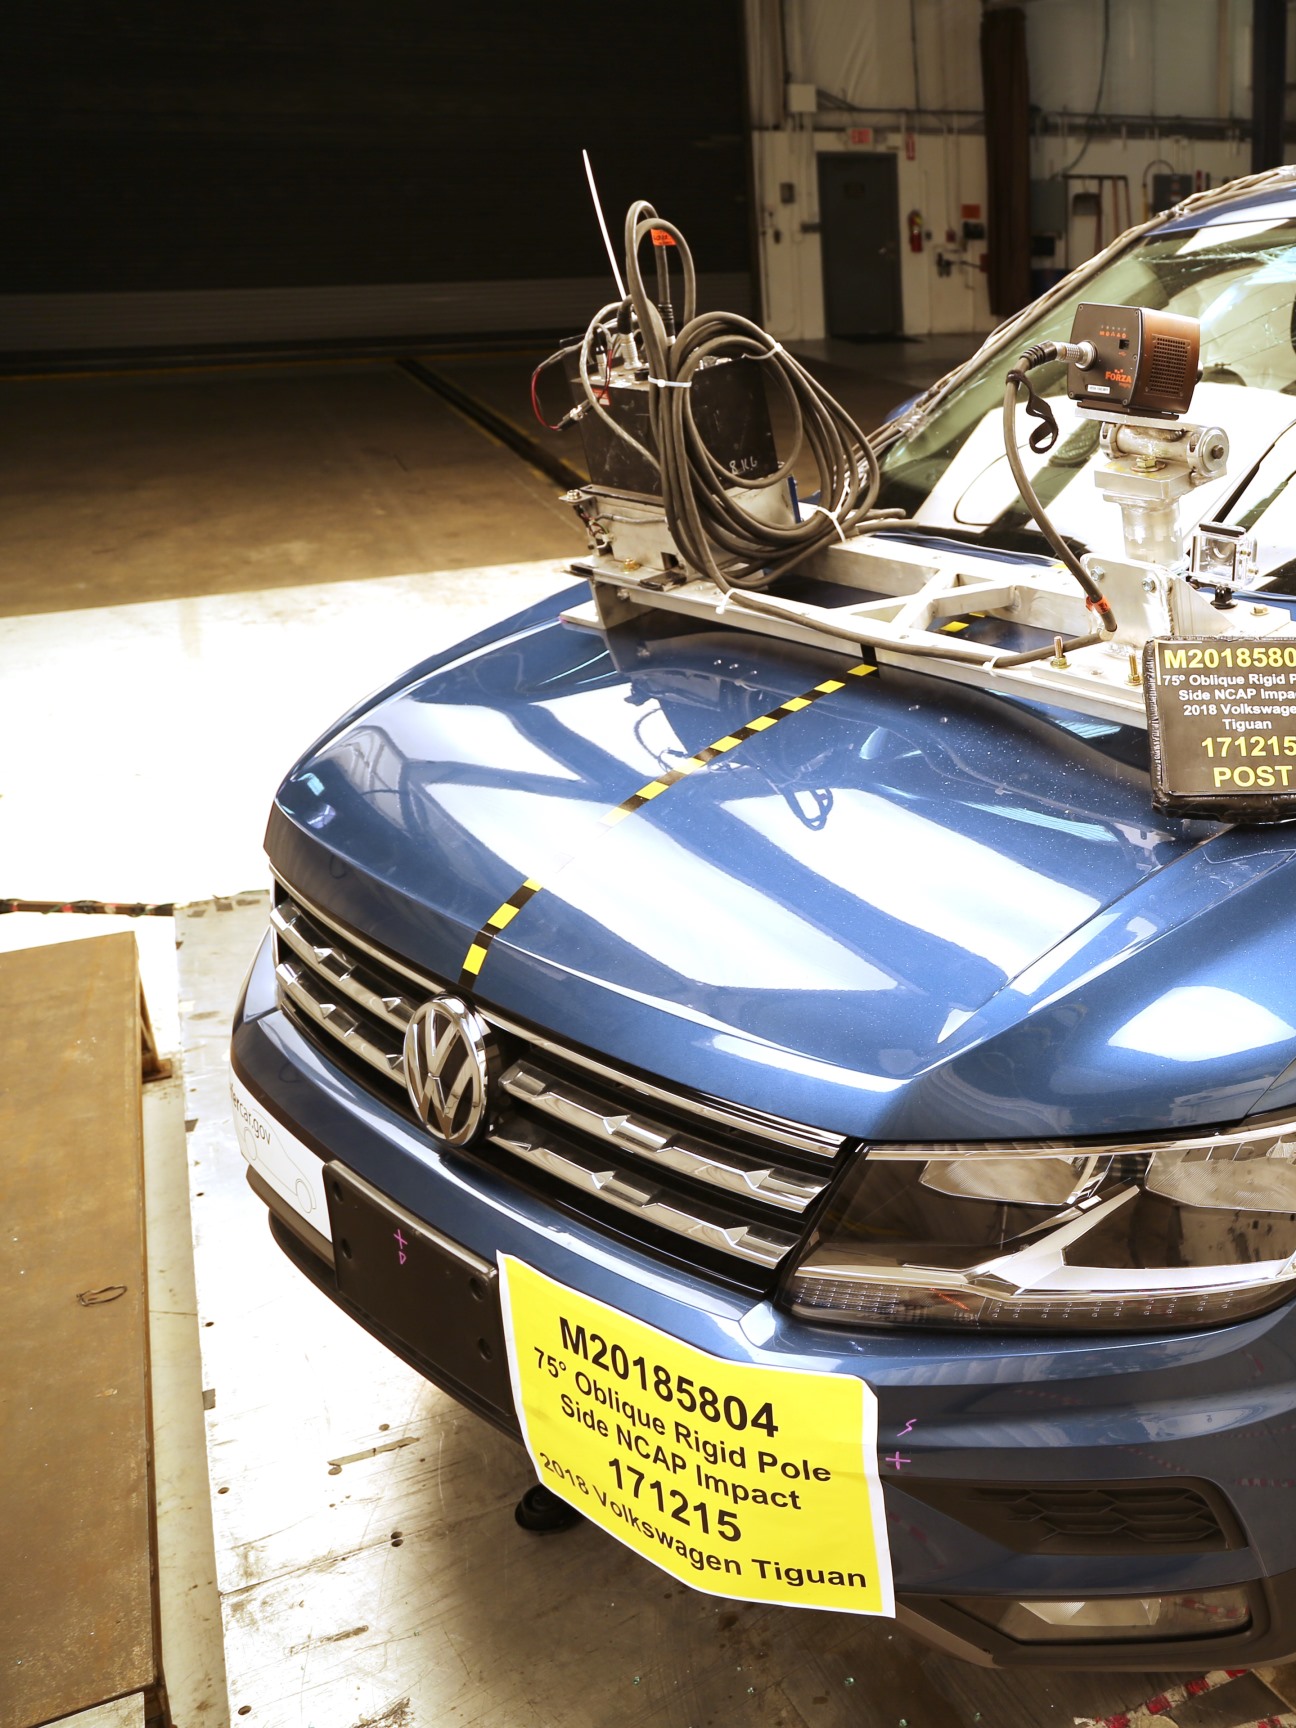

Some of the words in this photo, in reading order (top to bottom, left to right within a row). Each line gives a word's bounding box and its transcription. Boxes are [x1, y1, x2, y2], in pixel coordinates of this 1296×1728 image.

[1105, 371, 1133, 383] FORZA
[1188, 674, 1245, 688] Oblique
[1249, 673, 1286, 688] Rigid
[1178, 689, 1211, 701] Side
[1214, 688, 1257, 700] NCAP
[1183, 704, 1218, 716] 2018
[1222, 718, 1272, 733] Tiguan
[1213, 765, 1293, 788] POST
[559, 1316, 779, 1439] M20185804
[575, 1371, 666, 1436] Oblique
[674, 1421, 746, 1469] Rigid
[757, 1450, 831, 1482] Pole
[560, 1393, 609, 1438] Side
[616, 1423, 687, 1475] NCAP
[696, 1464, 802, 1510] Impact
[608, 1457, 742, 1543] 171215
[539, 1452, 589, 1496] 2018
[593, 1485, 742, 1576] Volkswagen
[751, 1558, 867, 1588] Tiguan
